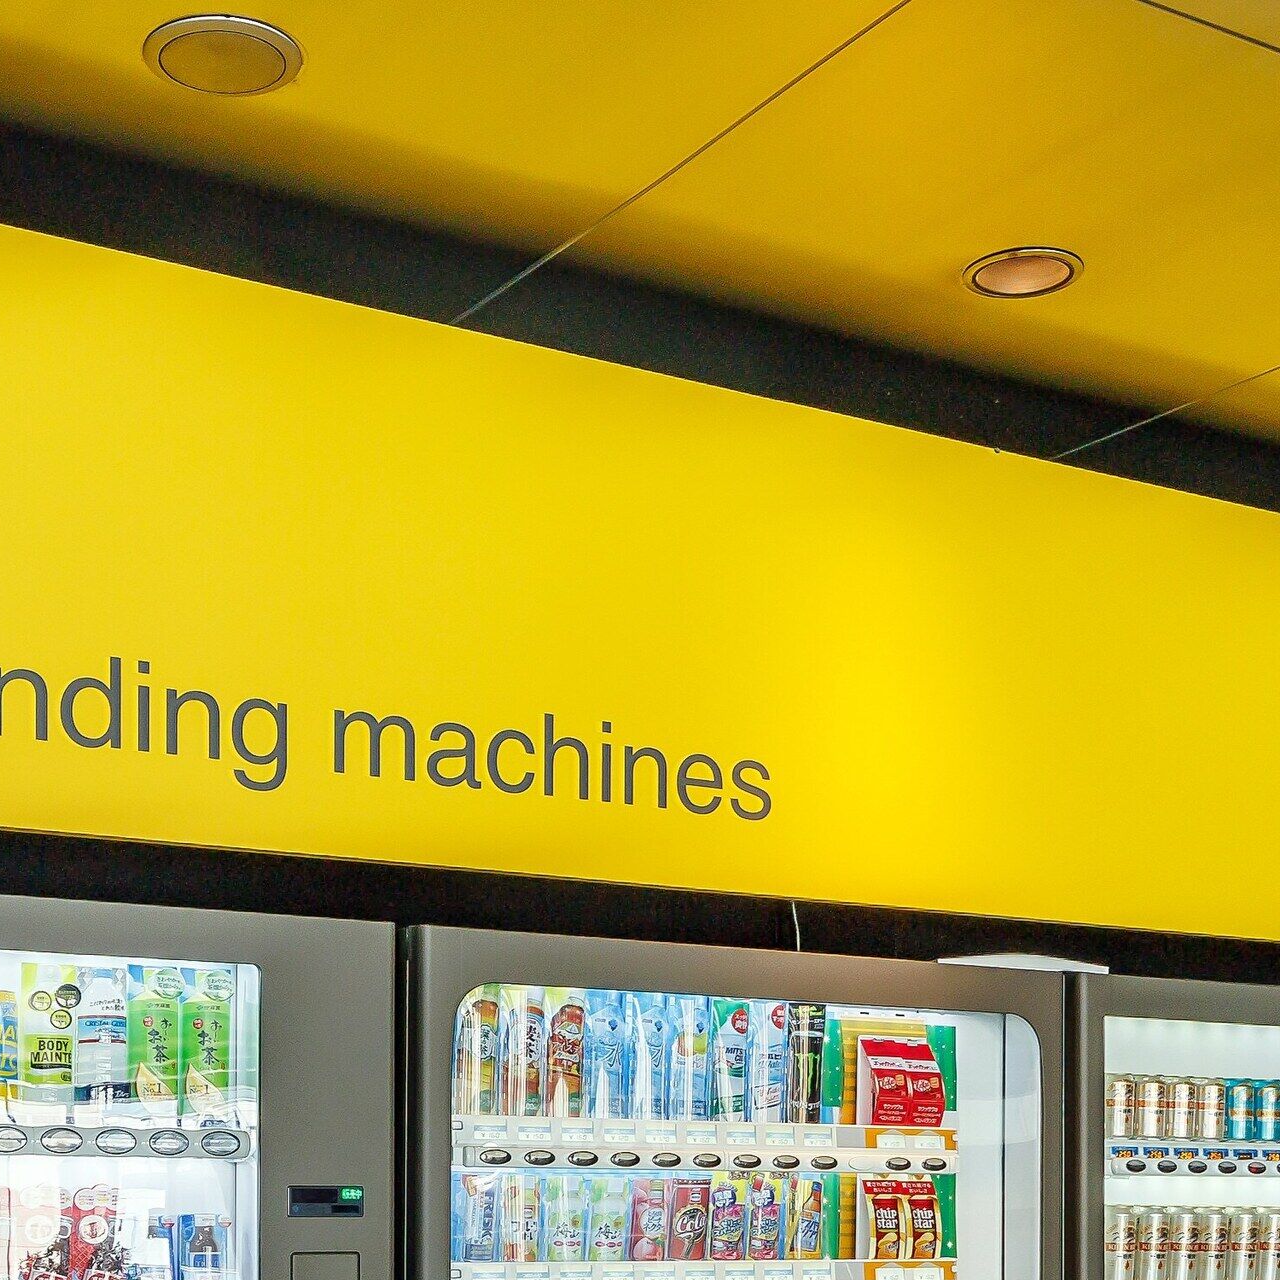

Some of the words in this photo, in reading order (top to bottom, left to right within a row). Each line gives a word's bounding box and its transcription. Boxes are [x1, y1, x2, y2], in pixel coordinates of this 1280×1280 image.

[333, 709, 773, 821] machines
[38, 1038, 70, 1051] BODY
[875, 1209, 898, 1220] chip
[912, 1209, 934, 1221] chip
[876, 1218, 898, 1230] star
[912, 1218, 935, 1230] star
